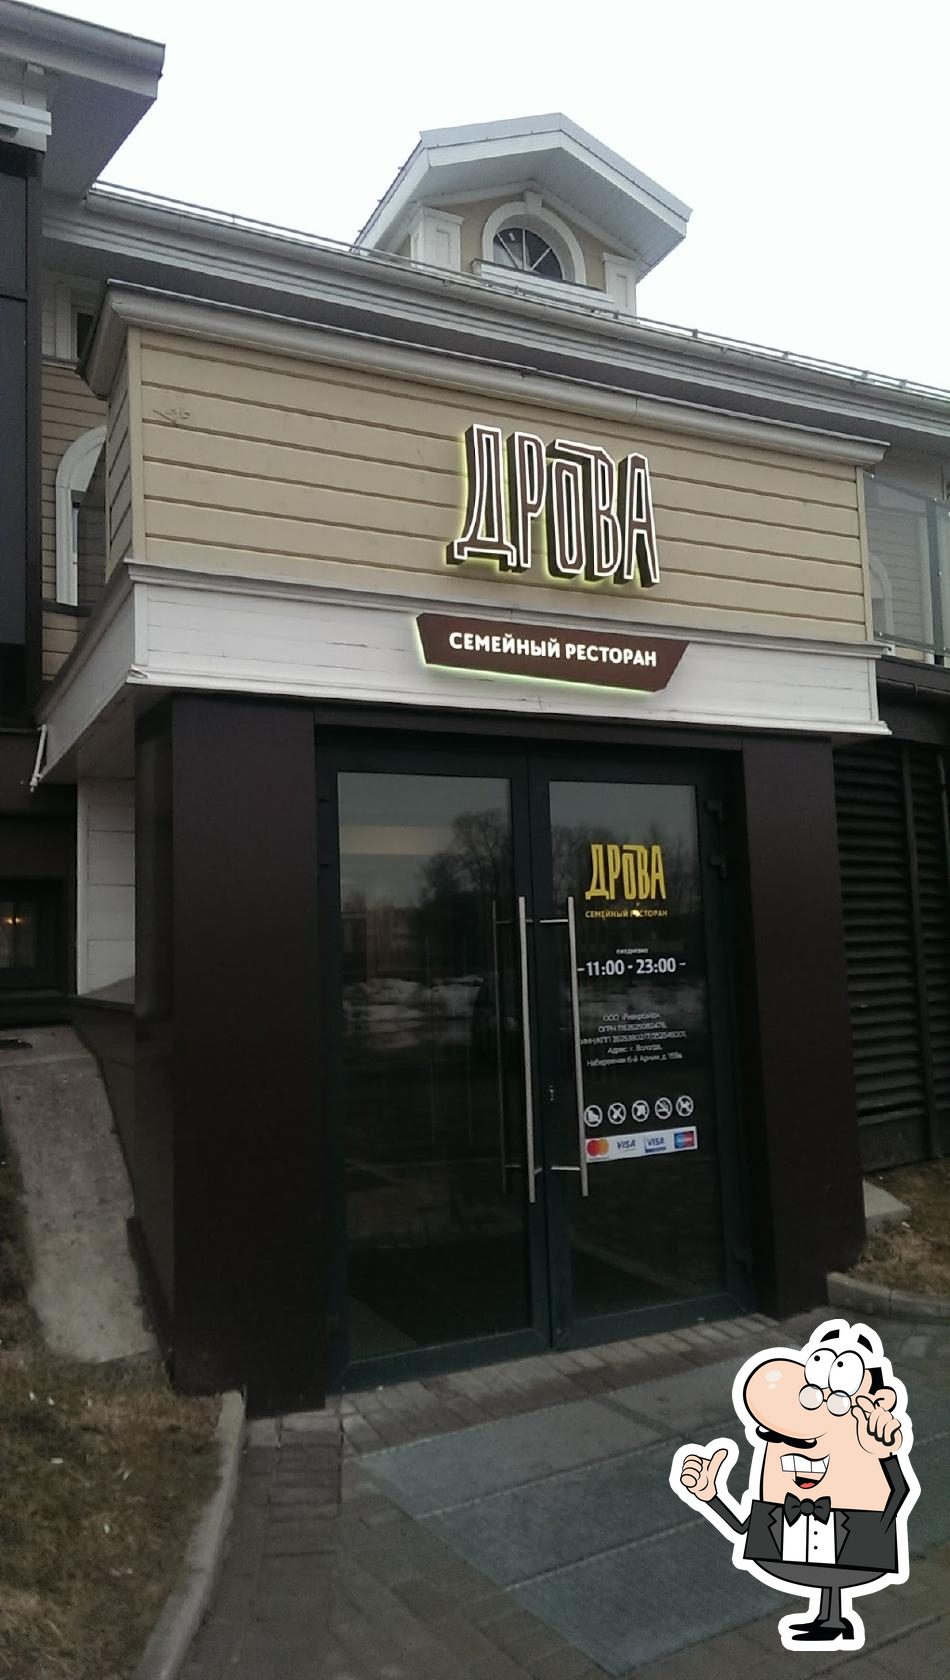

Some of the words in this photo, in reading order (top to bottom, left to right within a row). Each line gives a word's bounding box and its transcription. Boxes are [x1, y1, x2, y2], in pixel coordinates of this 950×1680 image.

[447, 423, 660, 588] ДРОВА
[449, 631, 561, 659] СЕМЕЙНЫЙ
[565, 643, 658, 667] РЕСТОРАН
[585, 844, 667, 900] ДРОВА
[585, 908, 629, 918] СЕМЕЙНЫЙ
[630, 909, 668, 918] РСТОРАН
[586, 960, 625, 977] 11:00
[636, 957, 676, 974] 23:00
[616, 1140, 636, 1150] VISA
[647, 1137, 665, 1147] VISA
